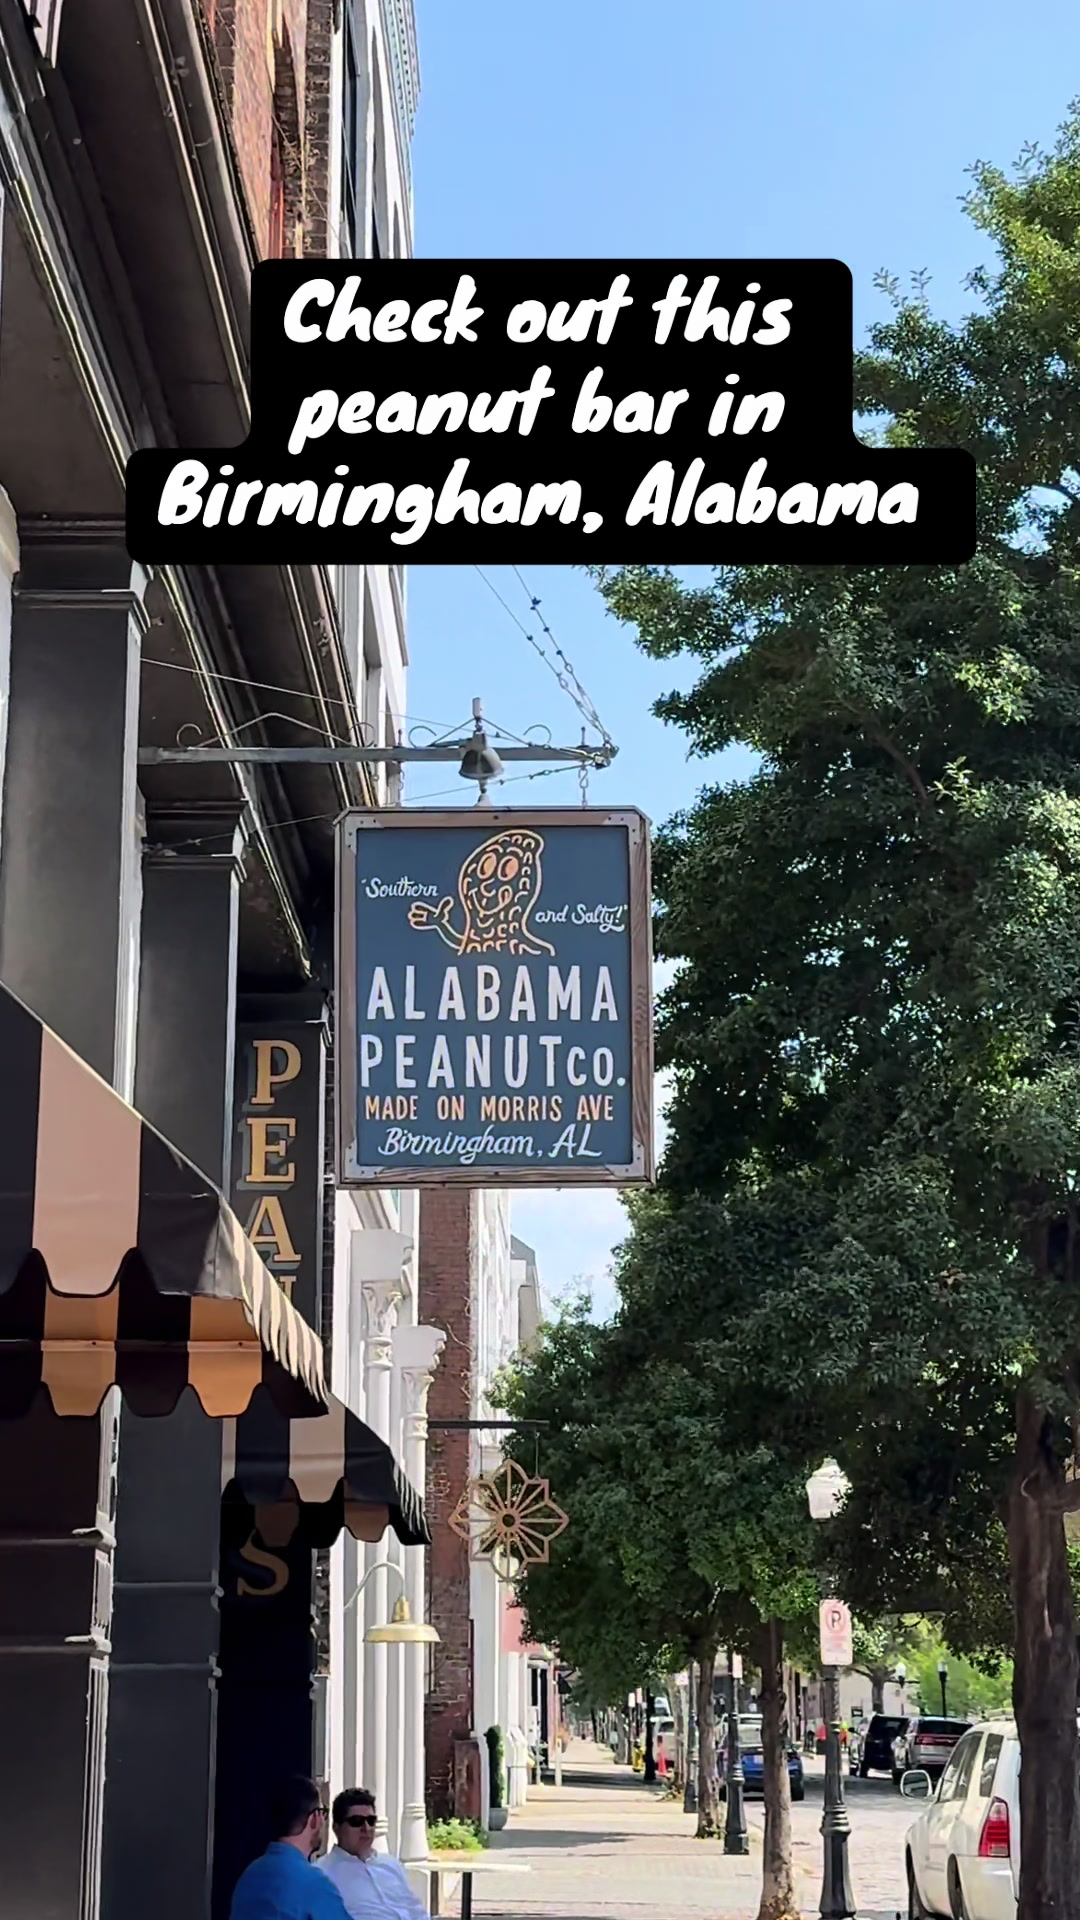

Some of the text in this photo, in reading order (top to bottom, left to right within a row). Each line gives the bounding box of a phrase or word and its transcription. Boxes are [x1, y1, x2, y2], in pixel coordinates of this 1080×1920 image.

[535, 904, 568, 923] and
[366, 965, 619, 1022] ALABAMA
[360, 1034, 562, 1089] PEANUT
[365, 1094, 614, 1122] MADE ON MORRIS AVE
[378, 1123, 602, 1164] Birmingham, AL
